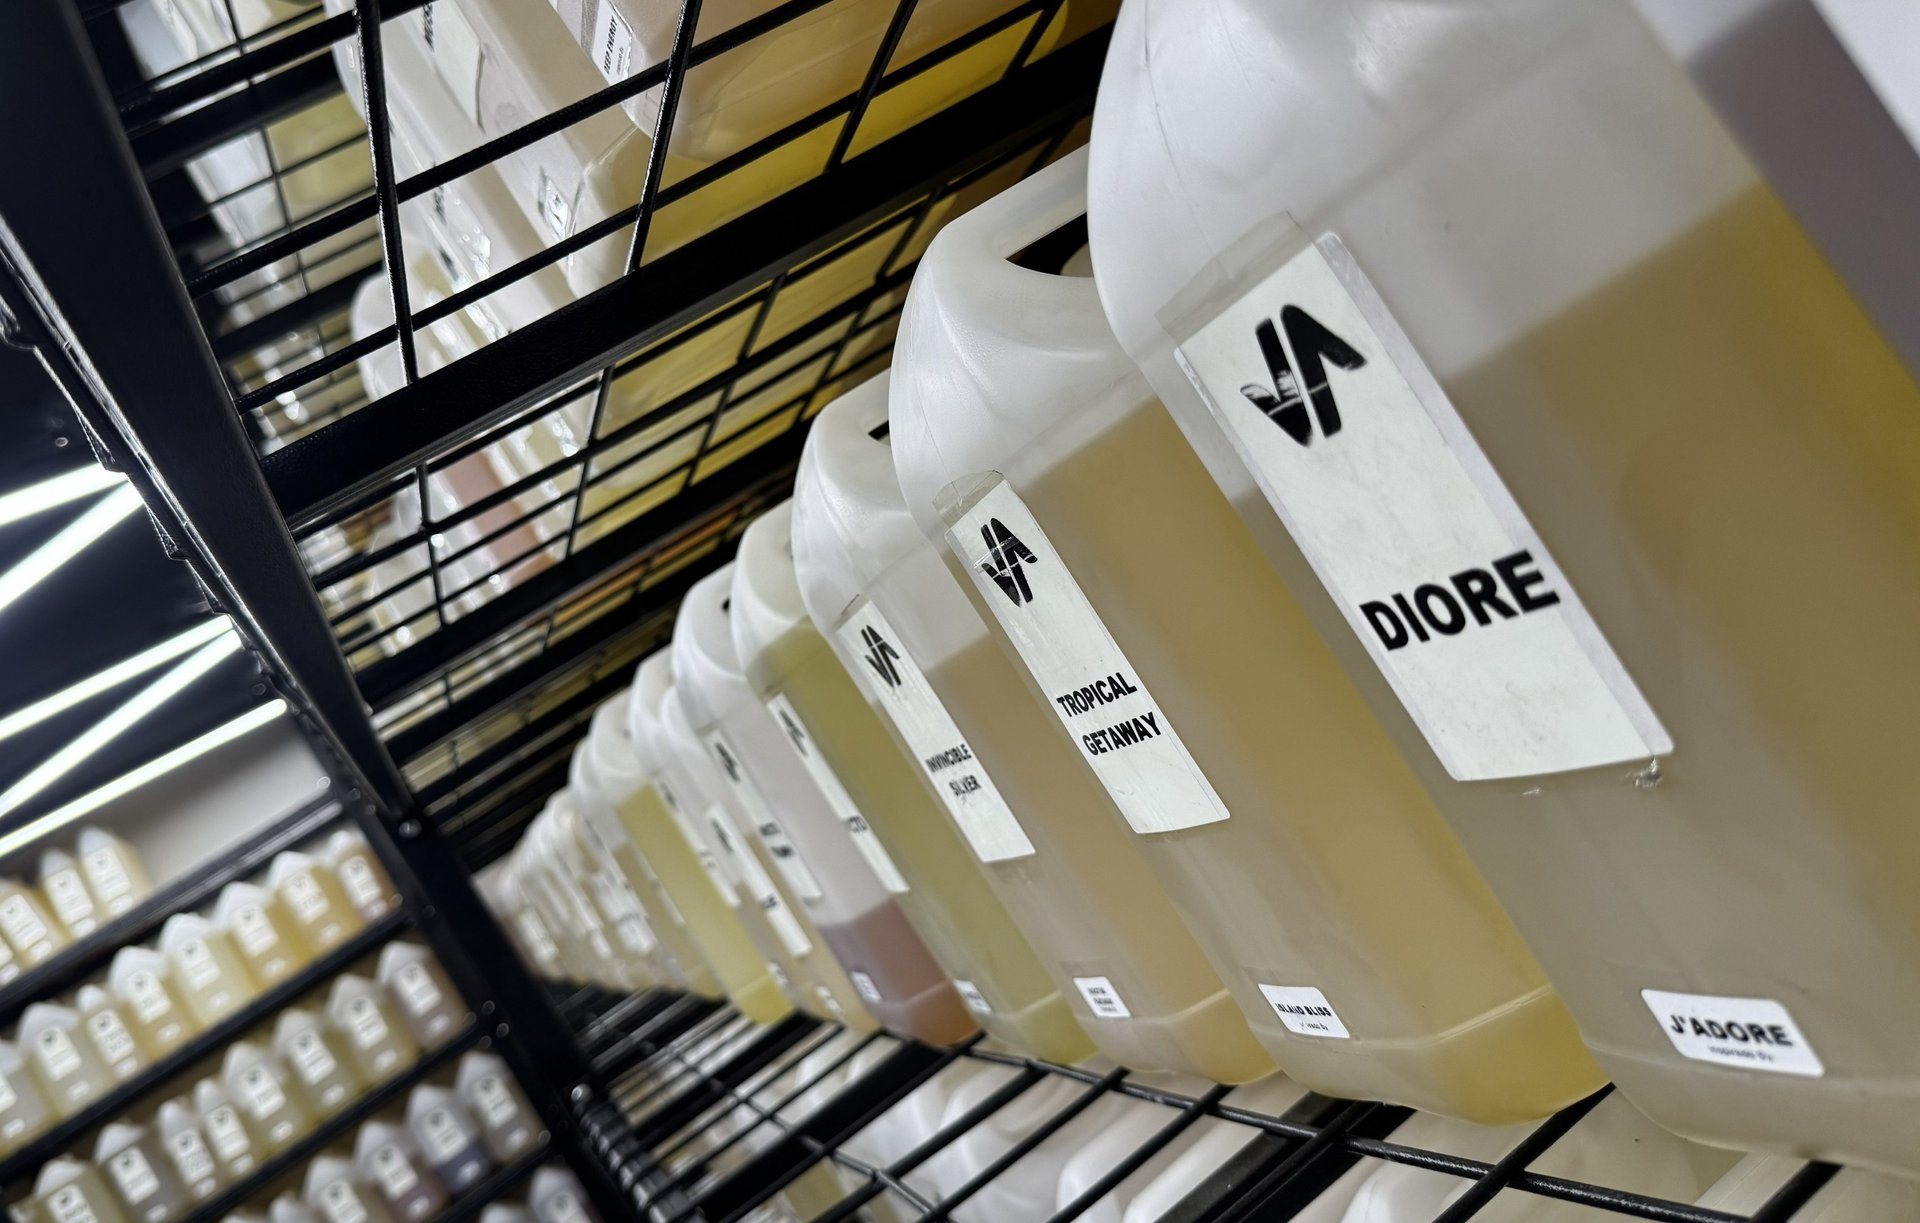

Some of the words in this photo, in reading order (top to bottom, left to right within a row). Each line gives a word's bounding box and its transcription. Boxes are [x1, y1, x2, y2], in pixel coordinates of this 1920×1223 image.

[607, 15, 617, 53] ENERGY
[1359, 549, 1560, 651] DIORE
[1056, 672, 1138, 717] TROPICAL
[1082, 711, 1161, 756] GETAWAY
[925, 744, 972, 772] INVINCIBLE
[1303, 1006, 1332, 1017] BLISS
[1670, 1014, 1794, 1047] J'ADORE
